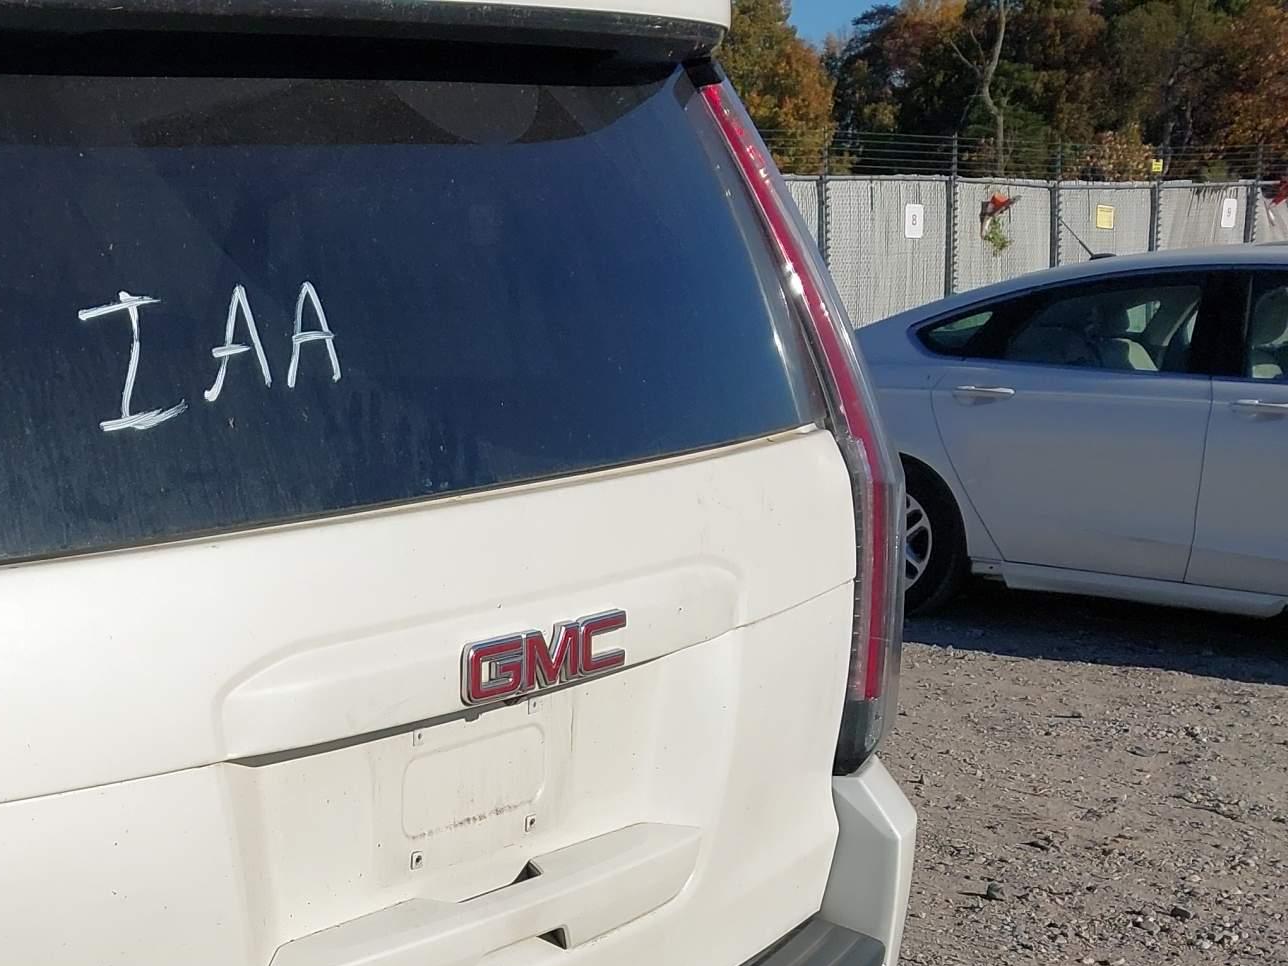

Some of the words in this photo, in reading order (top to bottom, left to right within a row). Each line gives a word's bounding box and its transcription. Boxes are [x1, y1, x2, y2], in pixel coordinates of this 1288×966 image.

[911, 214, 917, 226] 8
[78, 281, 342, 432] IAA
[460, 608, 627, 706] GMC
